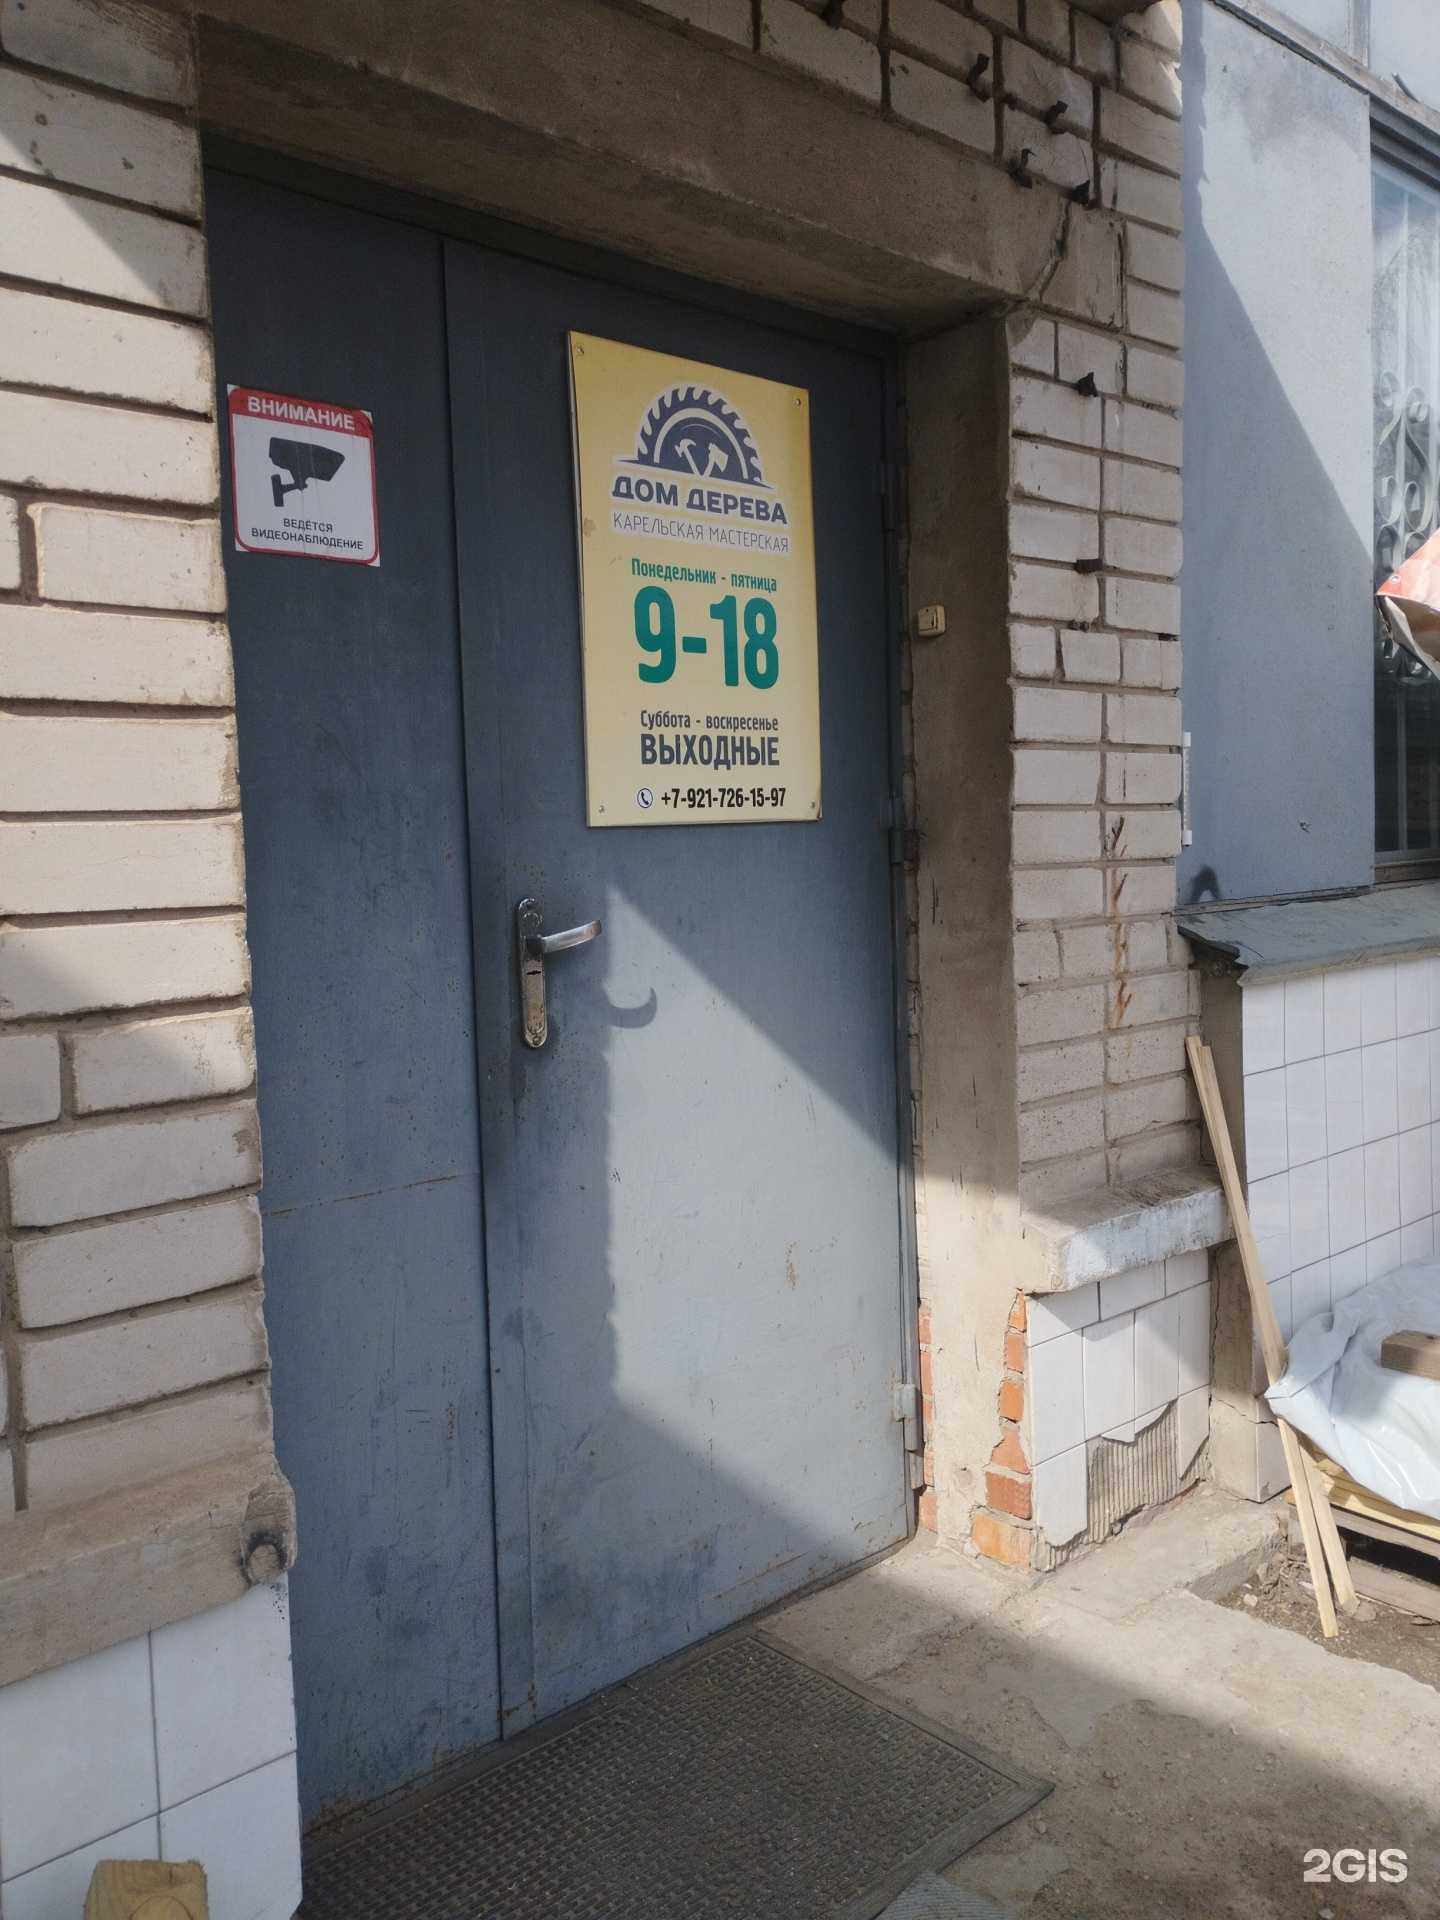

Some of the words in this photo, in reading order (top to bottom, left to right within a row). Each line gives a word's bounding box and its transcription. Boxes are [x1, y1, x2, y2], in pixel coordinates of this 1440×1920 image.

[247, 396, 356, 431] ВНИМАНИЕ
[612, 476, 679, 506] ДОМ
[686, 488, 788, 525] ДЕРЕВА
[251, 527, 364, 549] ВИДЕОНАБЛЮДЕНИЕ
[613, 512, 703, 541] КАРЕЛЬСКАЯ
[709, 527, 789, 552] МАСТЕРСКАЯ
[631, 558, 716, 584] Понедельник
[731, 572, 777, 592] пятница
[634, 586, 779, 689] 9-18
[640, 710, 691, 730] Суббота
[706, 715, 779, 732] воскресенье
[640, 733, 780, 770] ВЫХОДНЫЕ
[661, 787, 786, 808] +7-921-726-15-97
